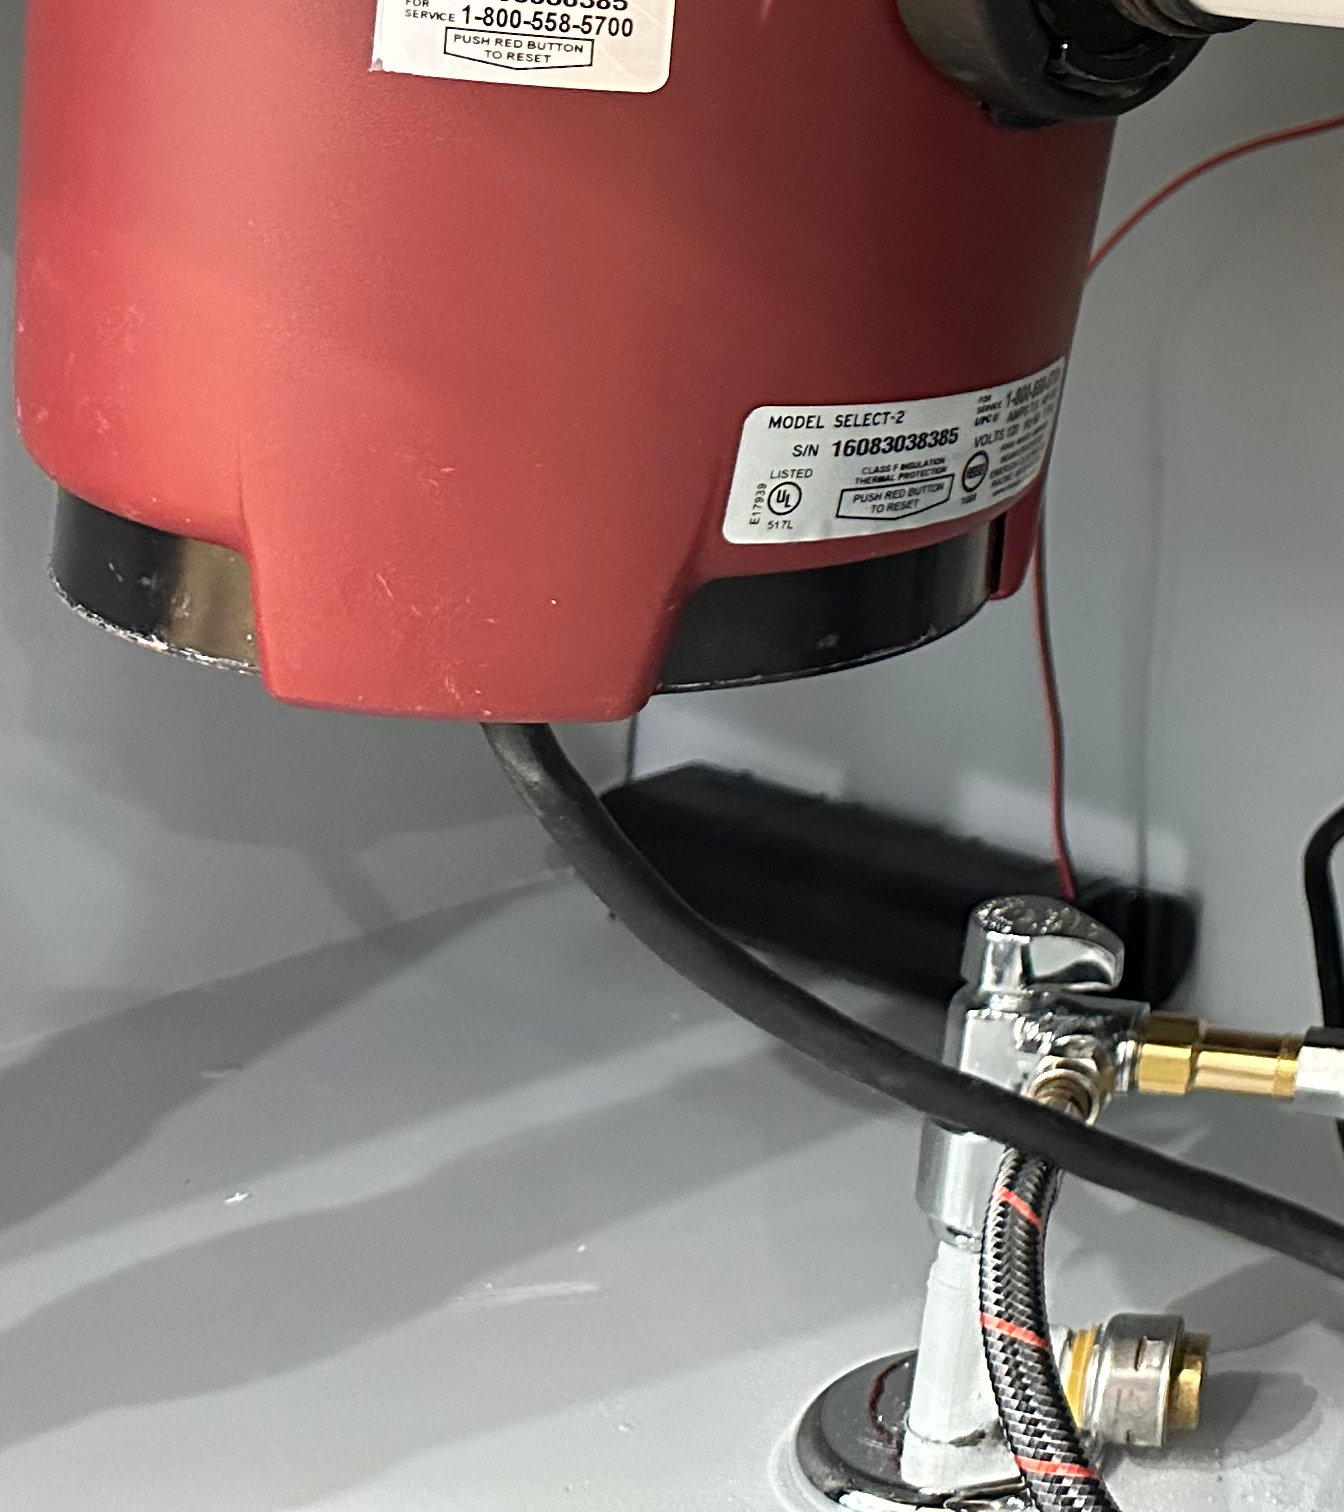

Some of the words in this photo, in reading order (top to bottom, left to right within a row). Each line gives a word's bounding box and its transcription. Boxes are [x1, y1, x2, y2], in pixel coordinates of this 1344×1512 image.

[404, 8, 456, 23] SERVICE
[461, 4, 635, 38] 1-800-558-5700
[453, 33, 491, 46] PUSH
[495, 37, 524, 50] RED
[527, 40, 584, 54] BUTTON
[484, 49, 503, 60] TO
[505, 51, 552, 64] RESET
[768, 415, 825, 430] MODEL
[834, 410, 906, 429] SELECT-2
[791, 444, 820, 458] S/N
[831, 427, 960, 458] 16083038385
[770, 468, 814, 479] LISTED
[855, 473, 896, 485] THERMAL
[898, 466, 948, 480] PROTECTION
[861, 465, 892, 476] CLASS
[900, 457, 946, 471] INSULATION
[852, 491, 884, 504] PUSH
[884, 488, 907, 501] RED
[907, 482, 946, 498] BUTTON
[749, 482, 768, 526] E17939
[870, 503, 885, 514] TO
[885, 499, 921, 512] RESET
[767, 519, 794, 530] 517L
